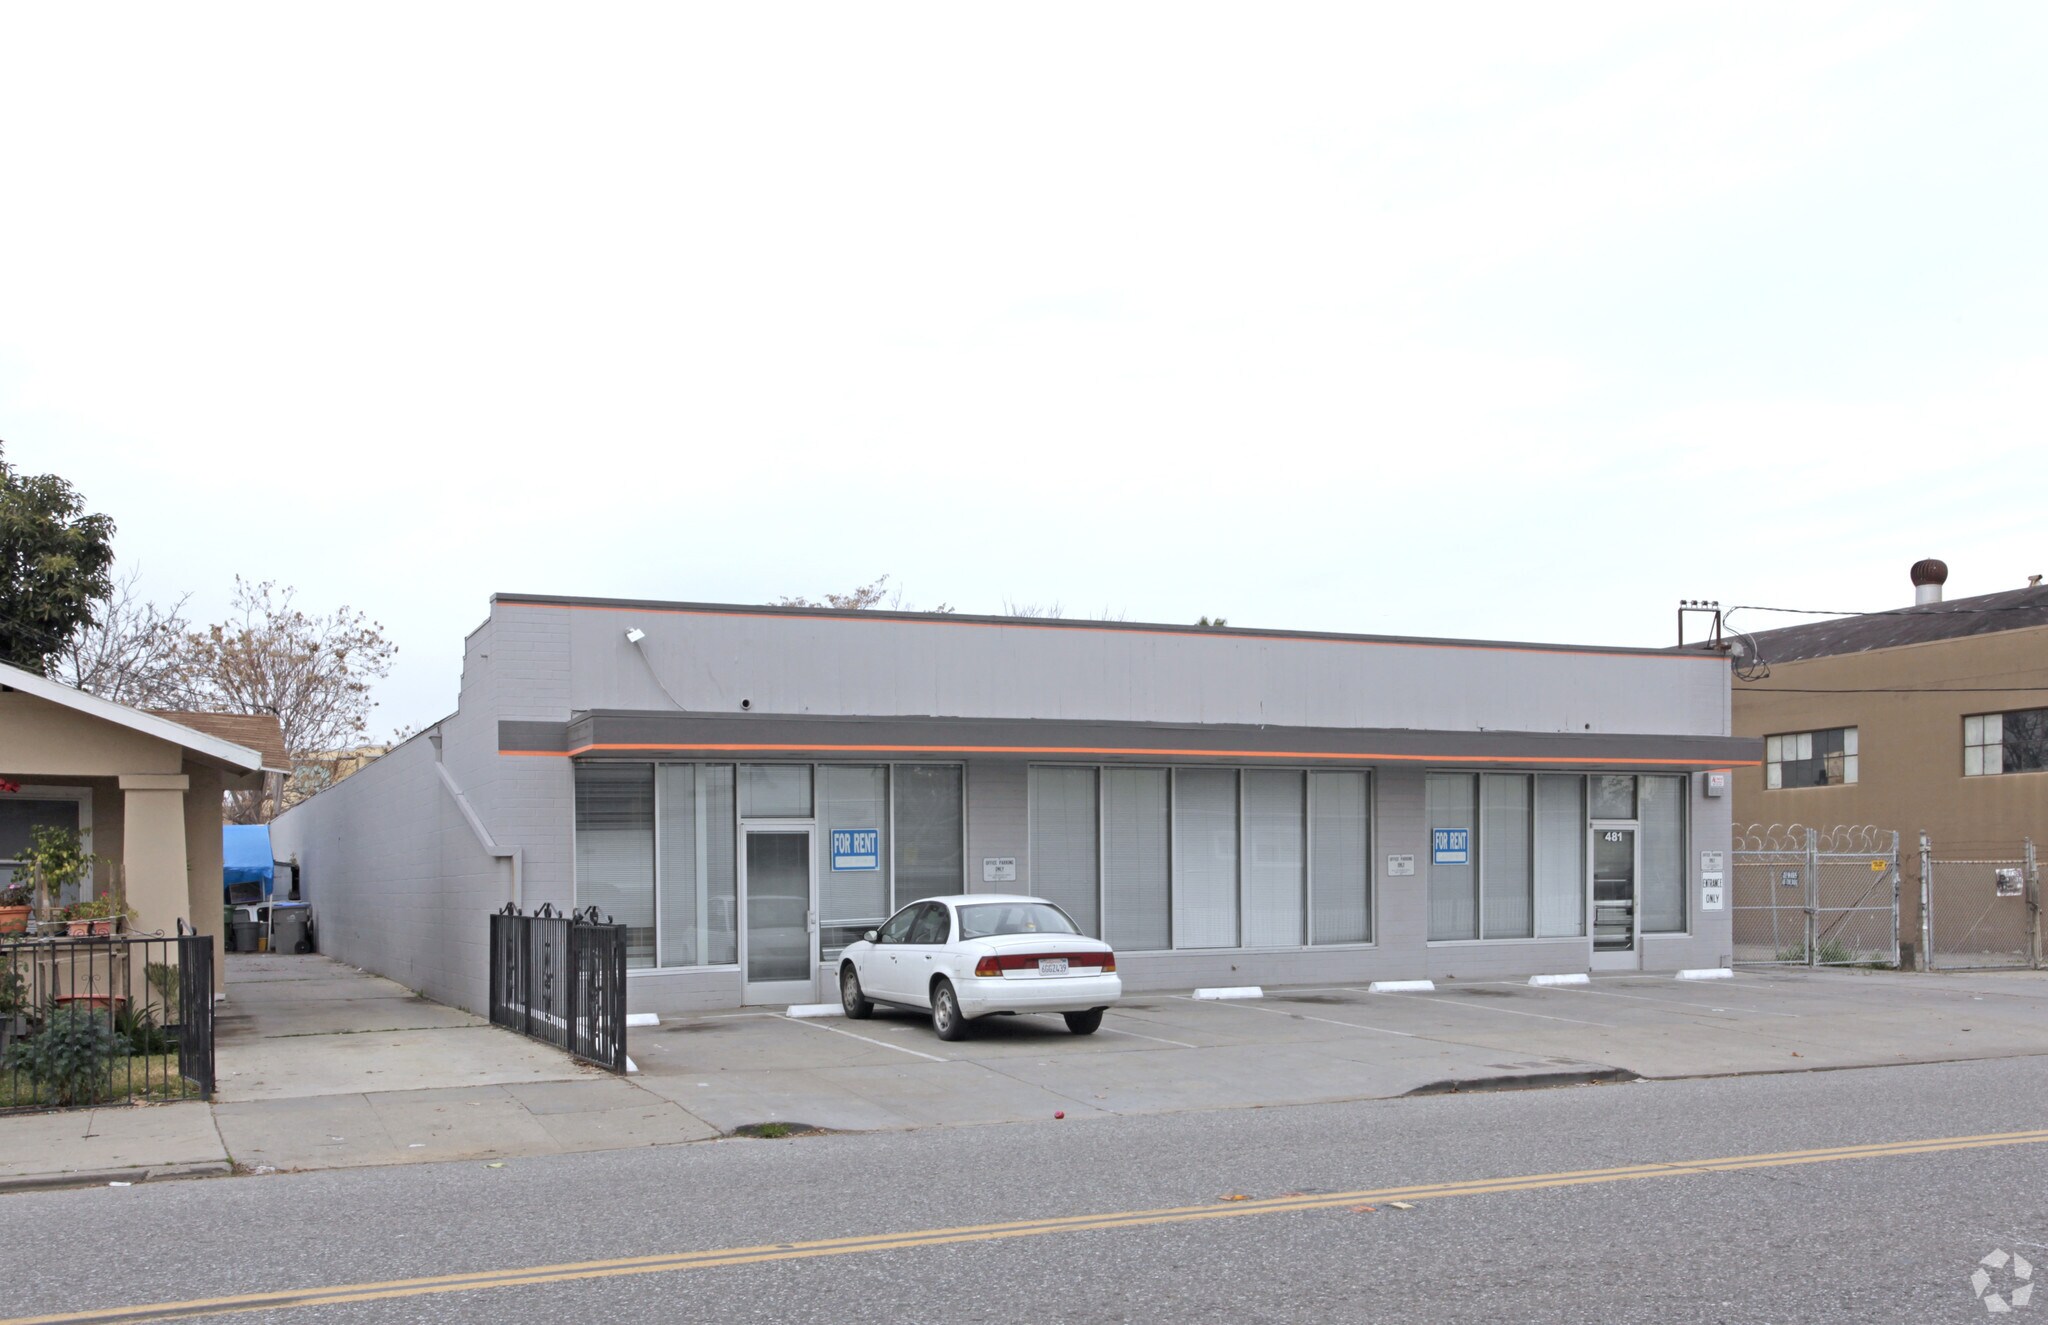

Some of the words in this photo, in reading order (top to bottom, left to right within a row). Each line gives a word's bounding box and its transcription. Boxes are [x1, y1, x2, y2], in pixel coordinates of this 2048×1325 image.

[1435, 832, 1448, 850] FOR
[1450, 832, 1466, 849] RENT
[1605, 831, 1622, 841] 481
[834, 832, 851, 854] FOR
[853, 832, 876, 853] RENT
[1702, 878, 1723, 888] ENTRANCE
[1705, 894, 1719, 903] ONLY
